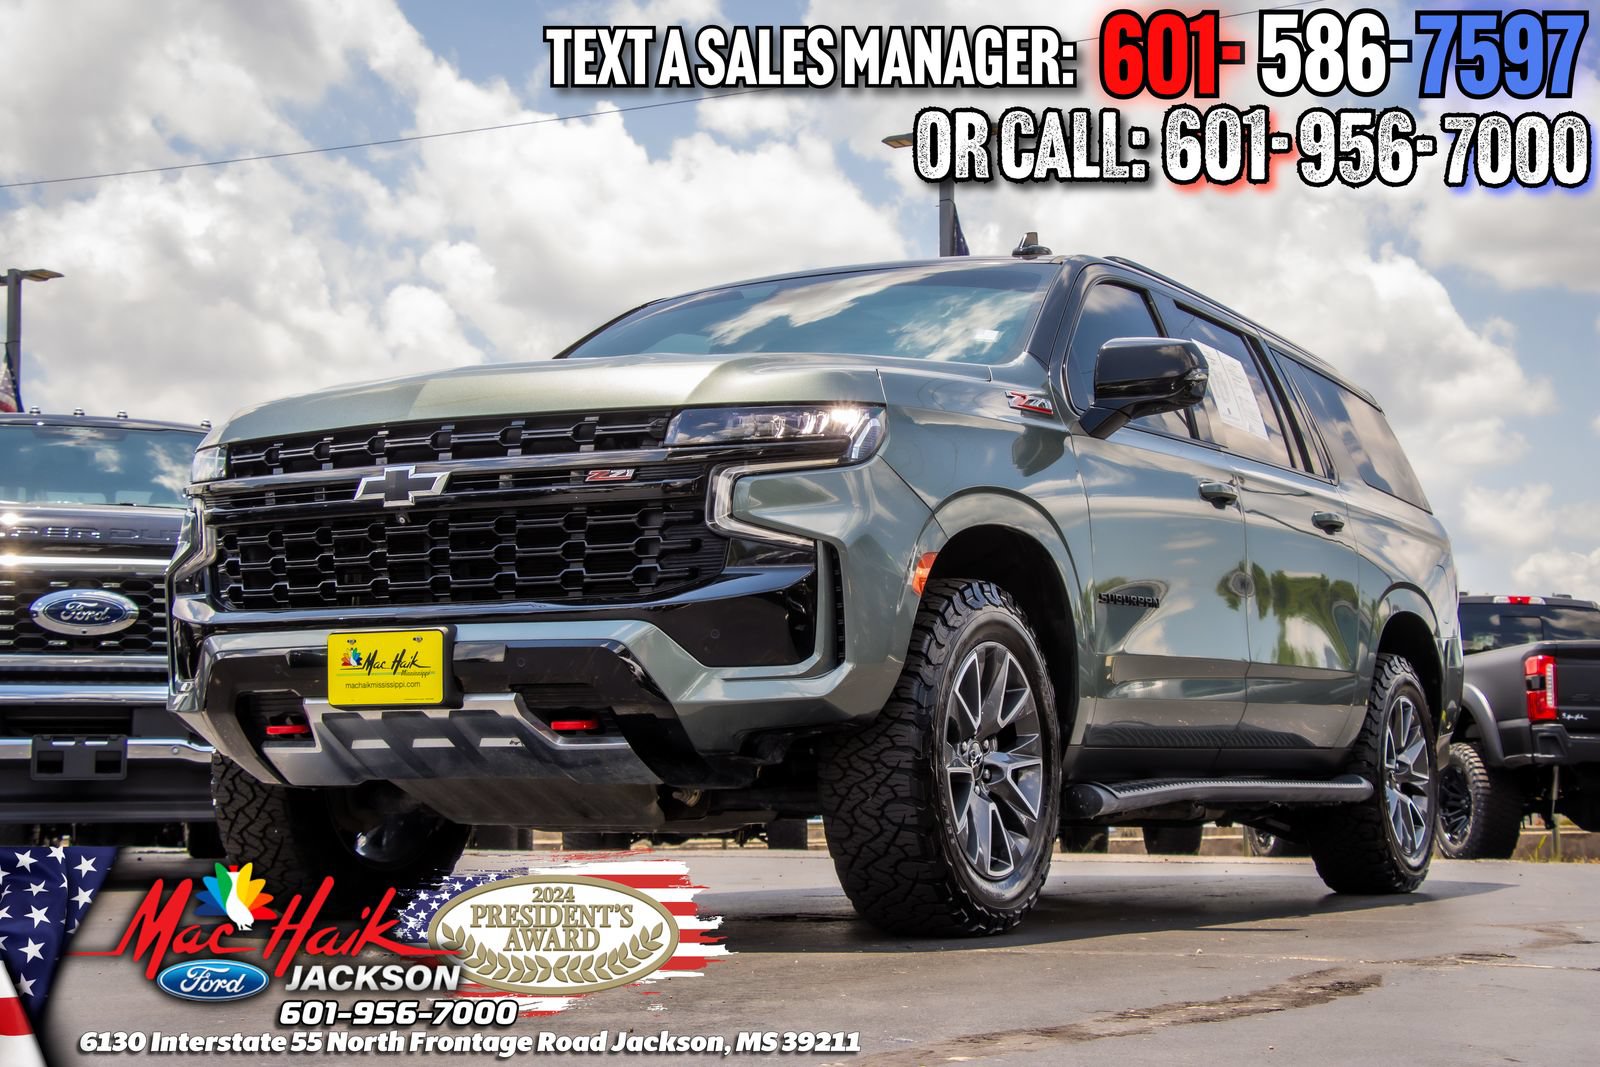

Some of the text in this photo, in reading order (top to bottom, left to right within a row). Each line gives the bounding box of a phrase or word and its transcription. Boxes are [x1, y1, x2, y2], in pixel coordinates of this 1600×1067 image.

[60, 601, 110, 621] Ford
[362, 648, 432, 676] Mac Haik
[345, 681, 421, 690] machaikmississippi.com
